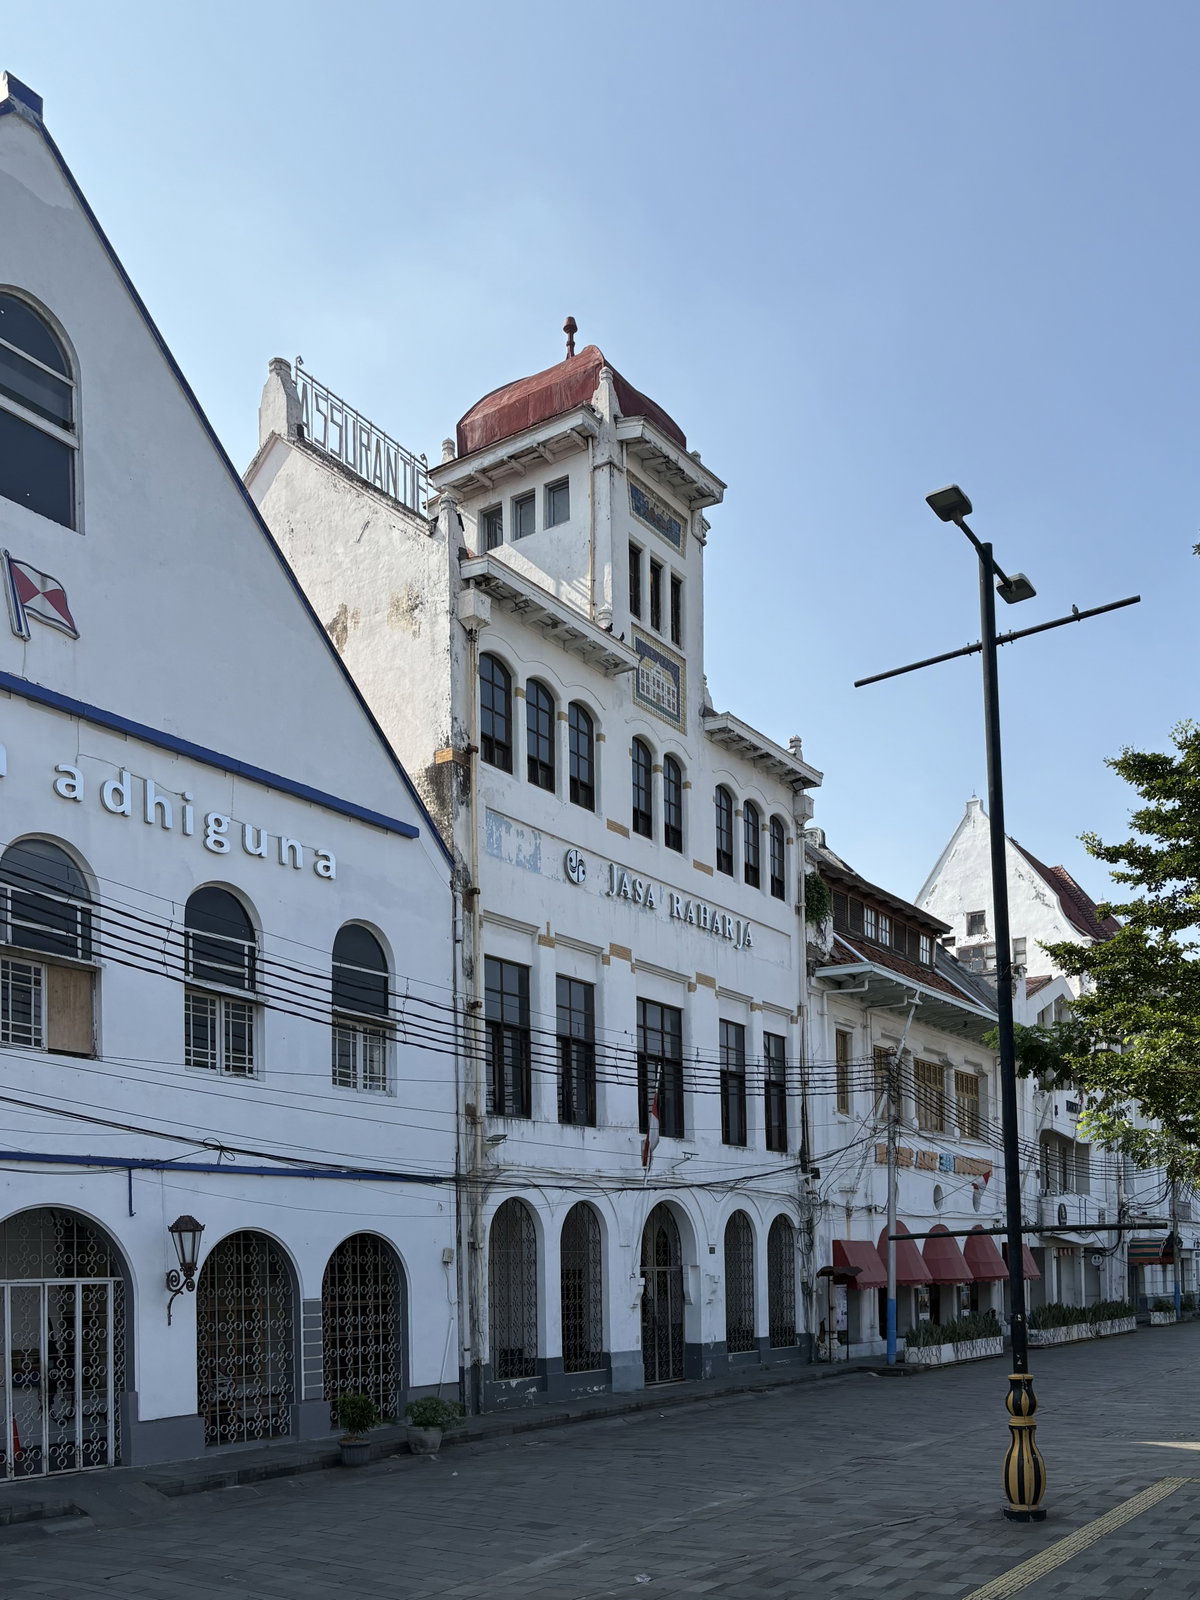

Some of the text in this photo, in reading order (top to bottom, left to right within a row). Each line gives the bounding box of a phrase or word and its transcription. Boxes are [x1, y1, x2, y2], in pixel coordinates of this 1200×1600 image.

[53, 764, 337, 880] adhiguna
[606, 863, 754, 949] JASA RAHARJA
